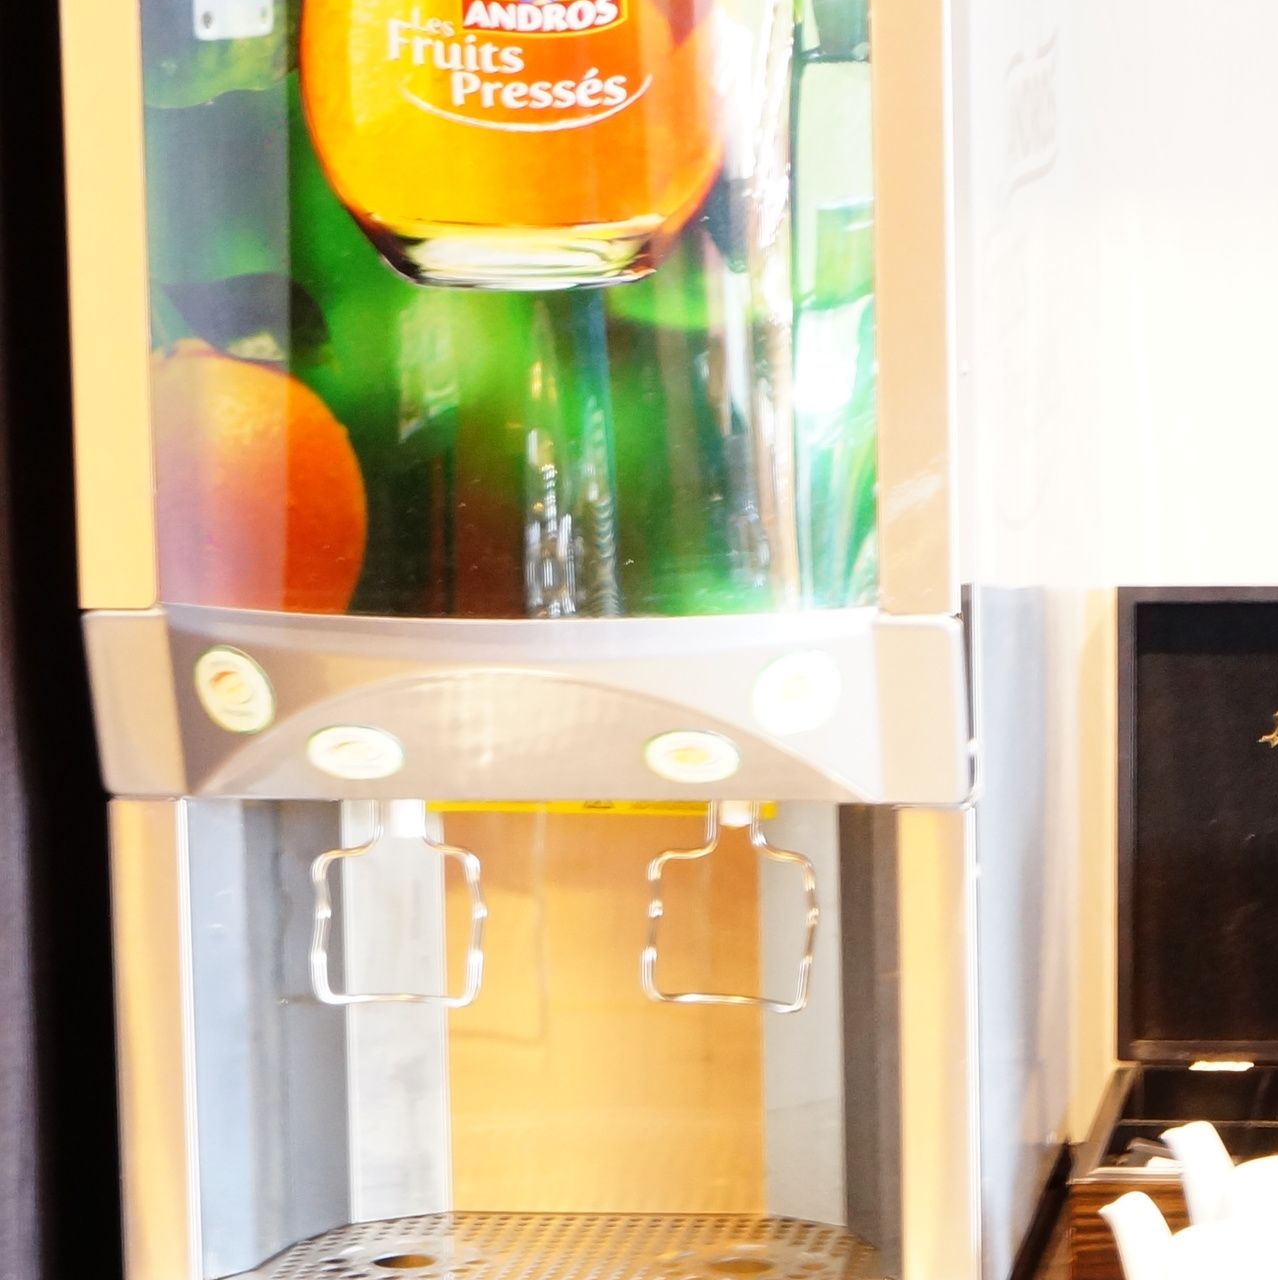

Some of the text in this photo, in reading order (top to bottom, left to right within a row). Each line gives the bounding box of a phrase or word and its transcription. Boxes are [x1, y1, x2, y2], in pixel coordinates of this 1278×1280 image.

[412, 8, 456, 38] Les
[388, 18, 525, 74] Fruits
[451, 67, 629, 109] Pressés
